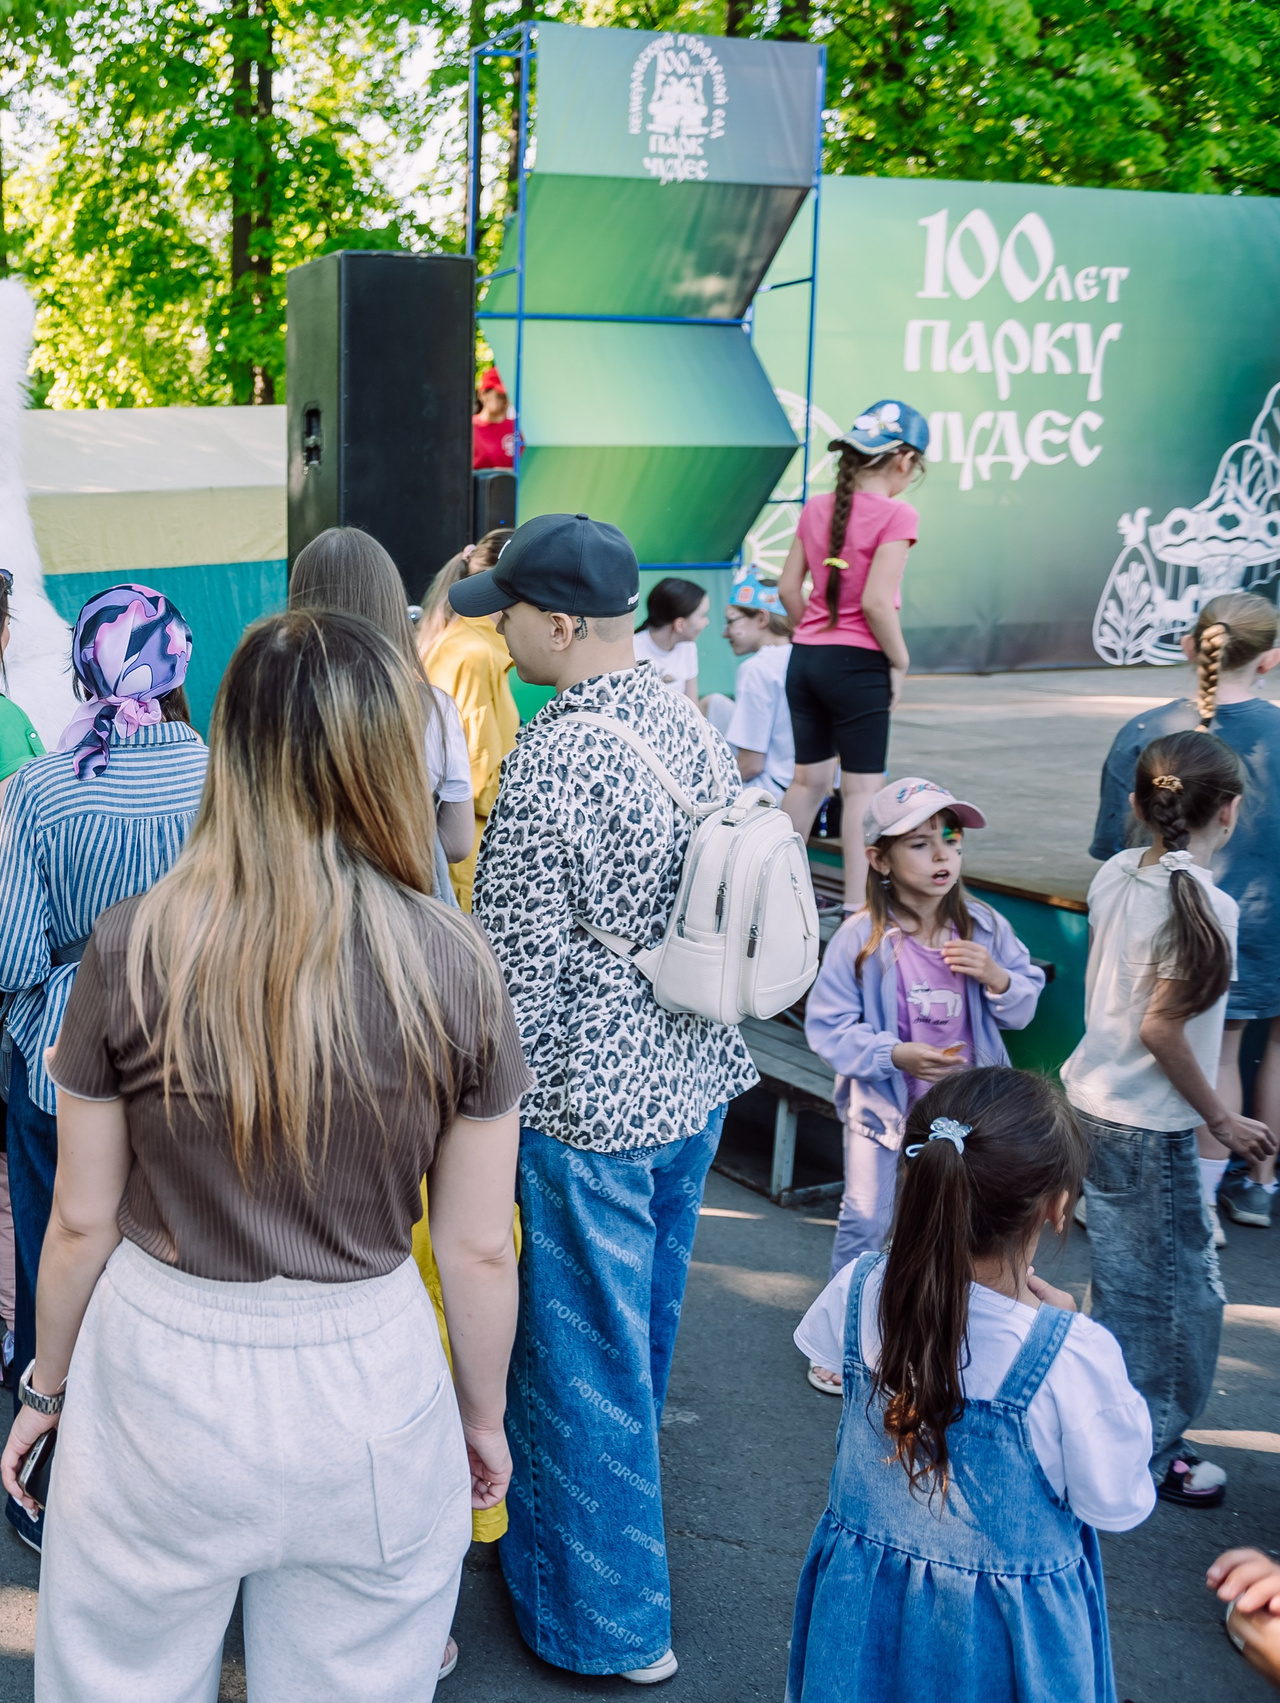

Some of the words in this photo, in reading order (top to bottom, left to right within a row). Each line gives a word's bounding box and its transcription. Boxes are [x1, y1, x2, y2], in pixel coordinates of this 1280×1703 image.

[915, 208, 1055, 303] 100
[586, 1227, 643, 1272] POROSUS
[546, 1299, 620, 1360] POROSUS
[569, 1376, 643, 1434] POROSUS
[598, 1452, 658, 1499] POROSUS
[553, 1523, 621, 1586] POROSUS
[574, 1599, 644, 1648] POROSUS
